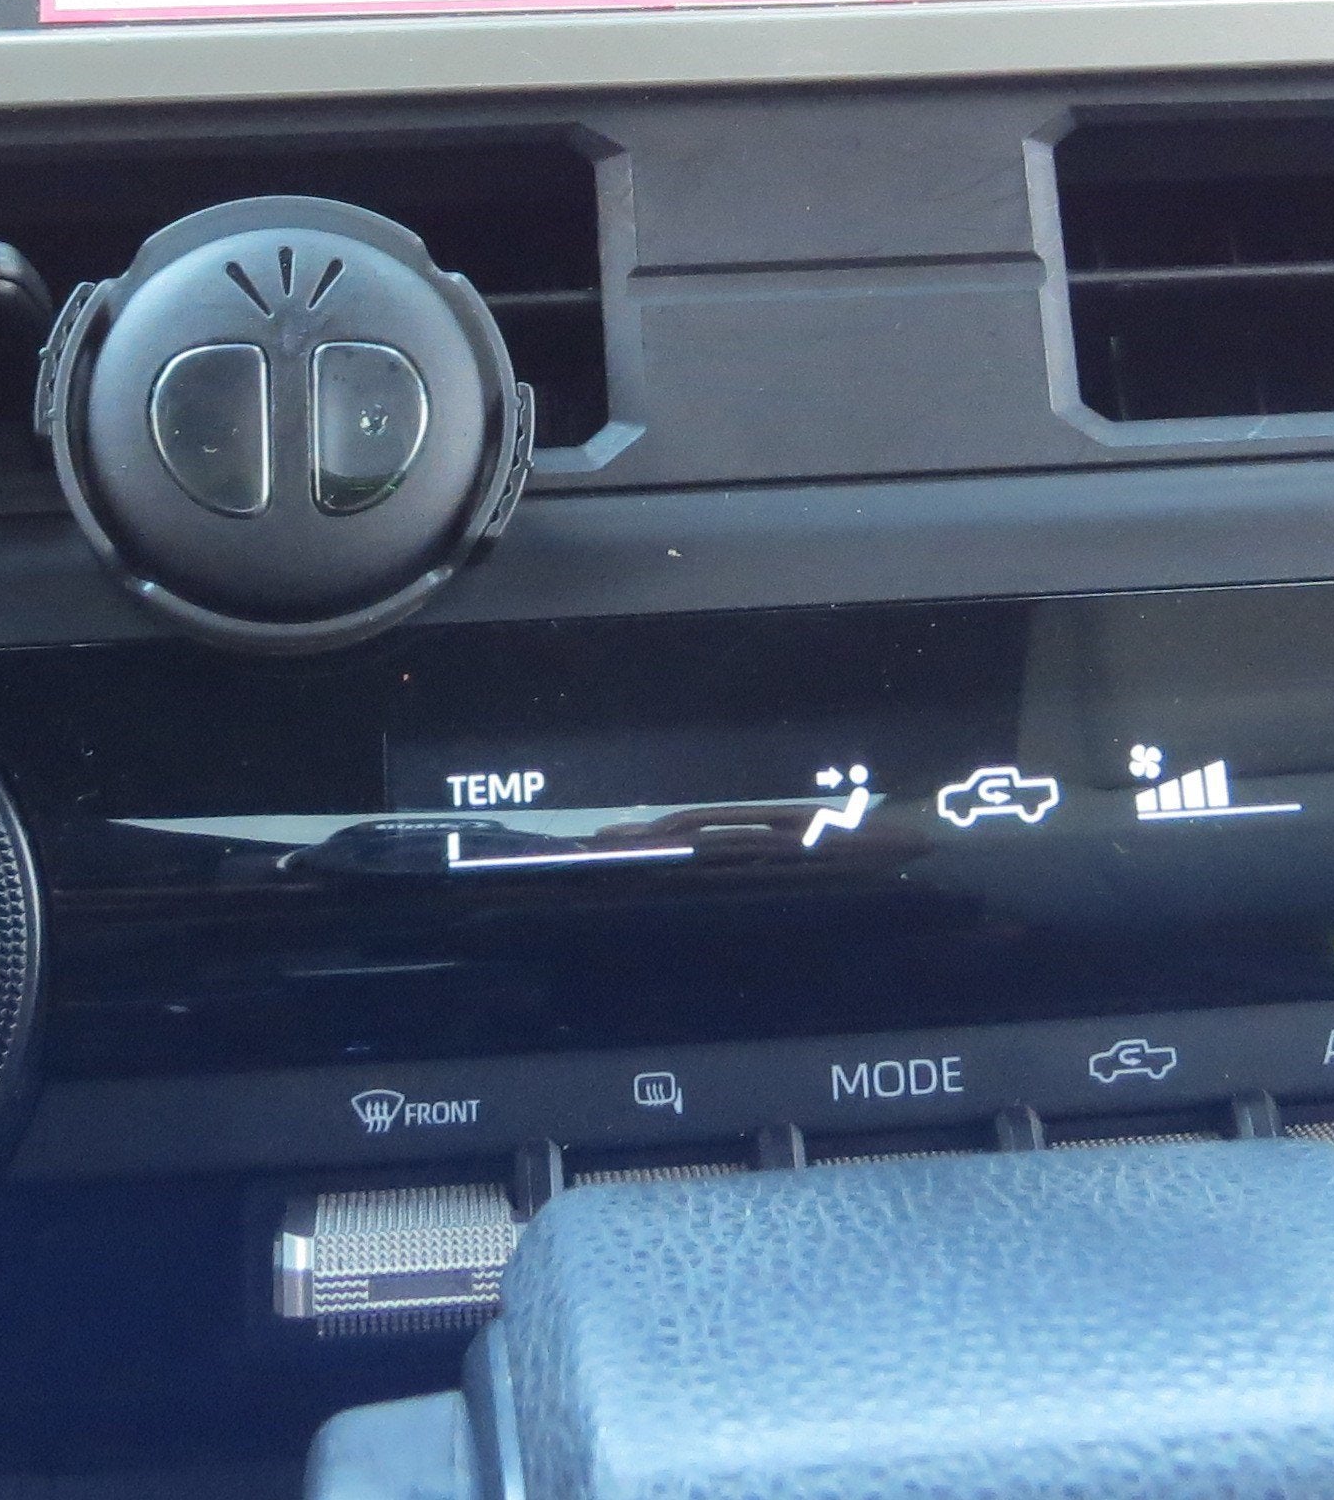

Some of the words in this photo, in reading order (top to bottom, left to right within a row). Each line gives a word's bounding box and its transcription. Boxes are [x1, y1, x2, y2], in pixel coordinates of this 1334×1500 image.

[446, 771, 545, 807] TEMP
[831, 1056, 963, 1101] MODE
[404, 1099, 480, 1126] FRONT
